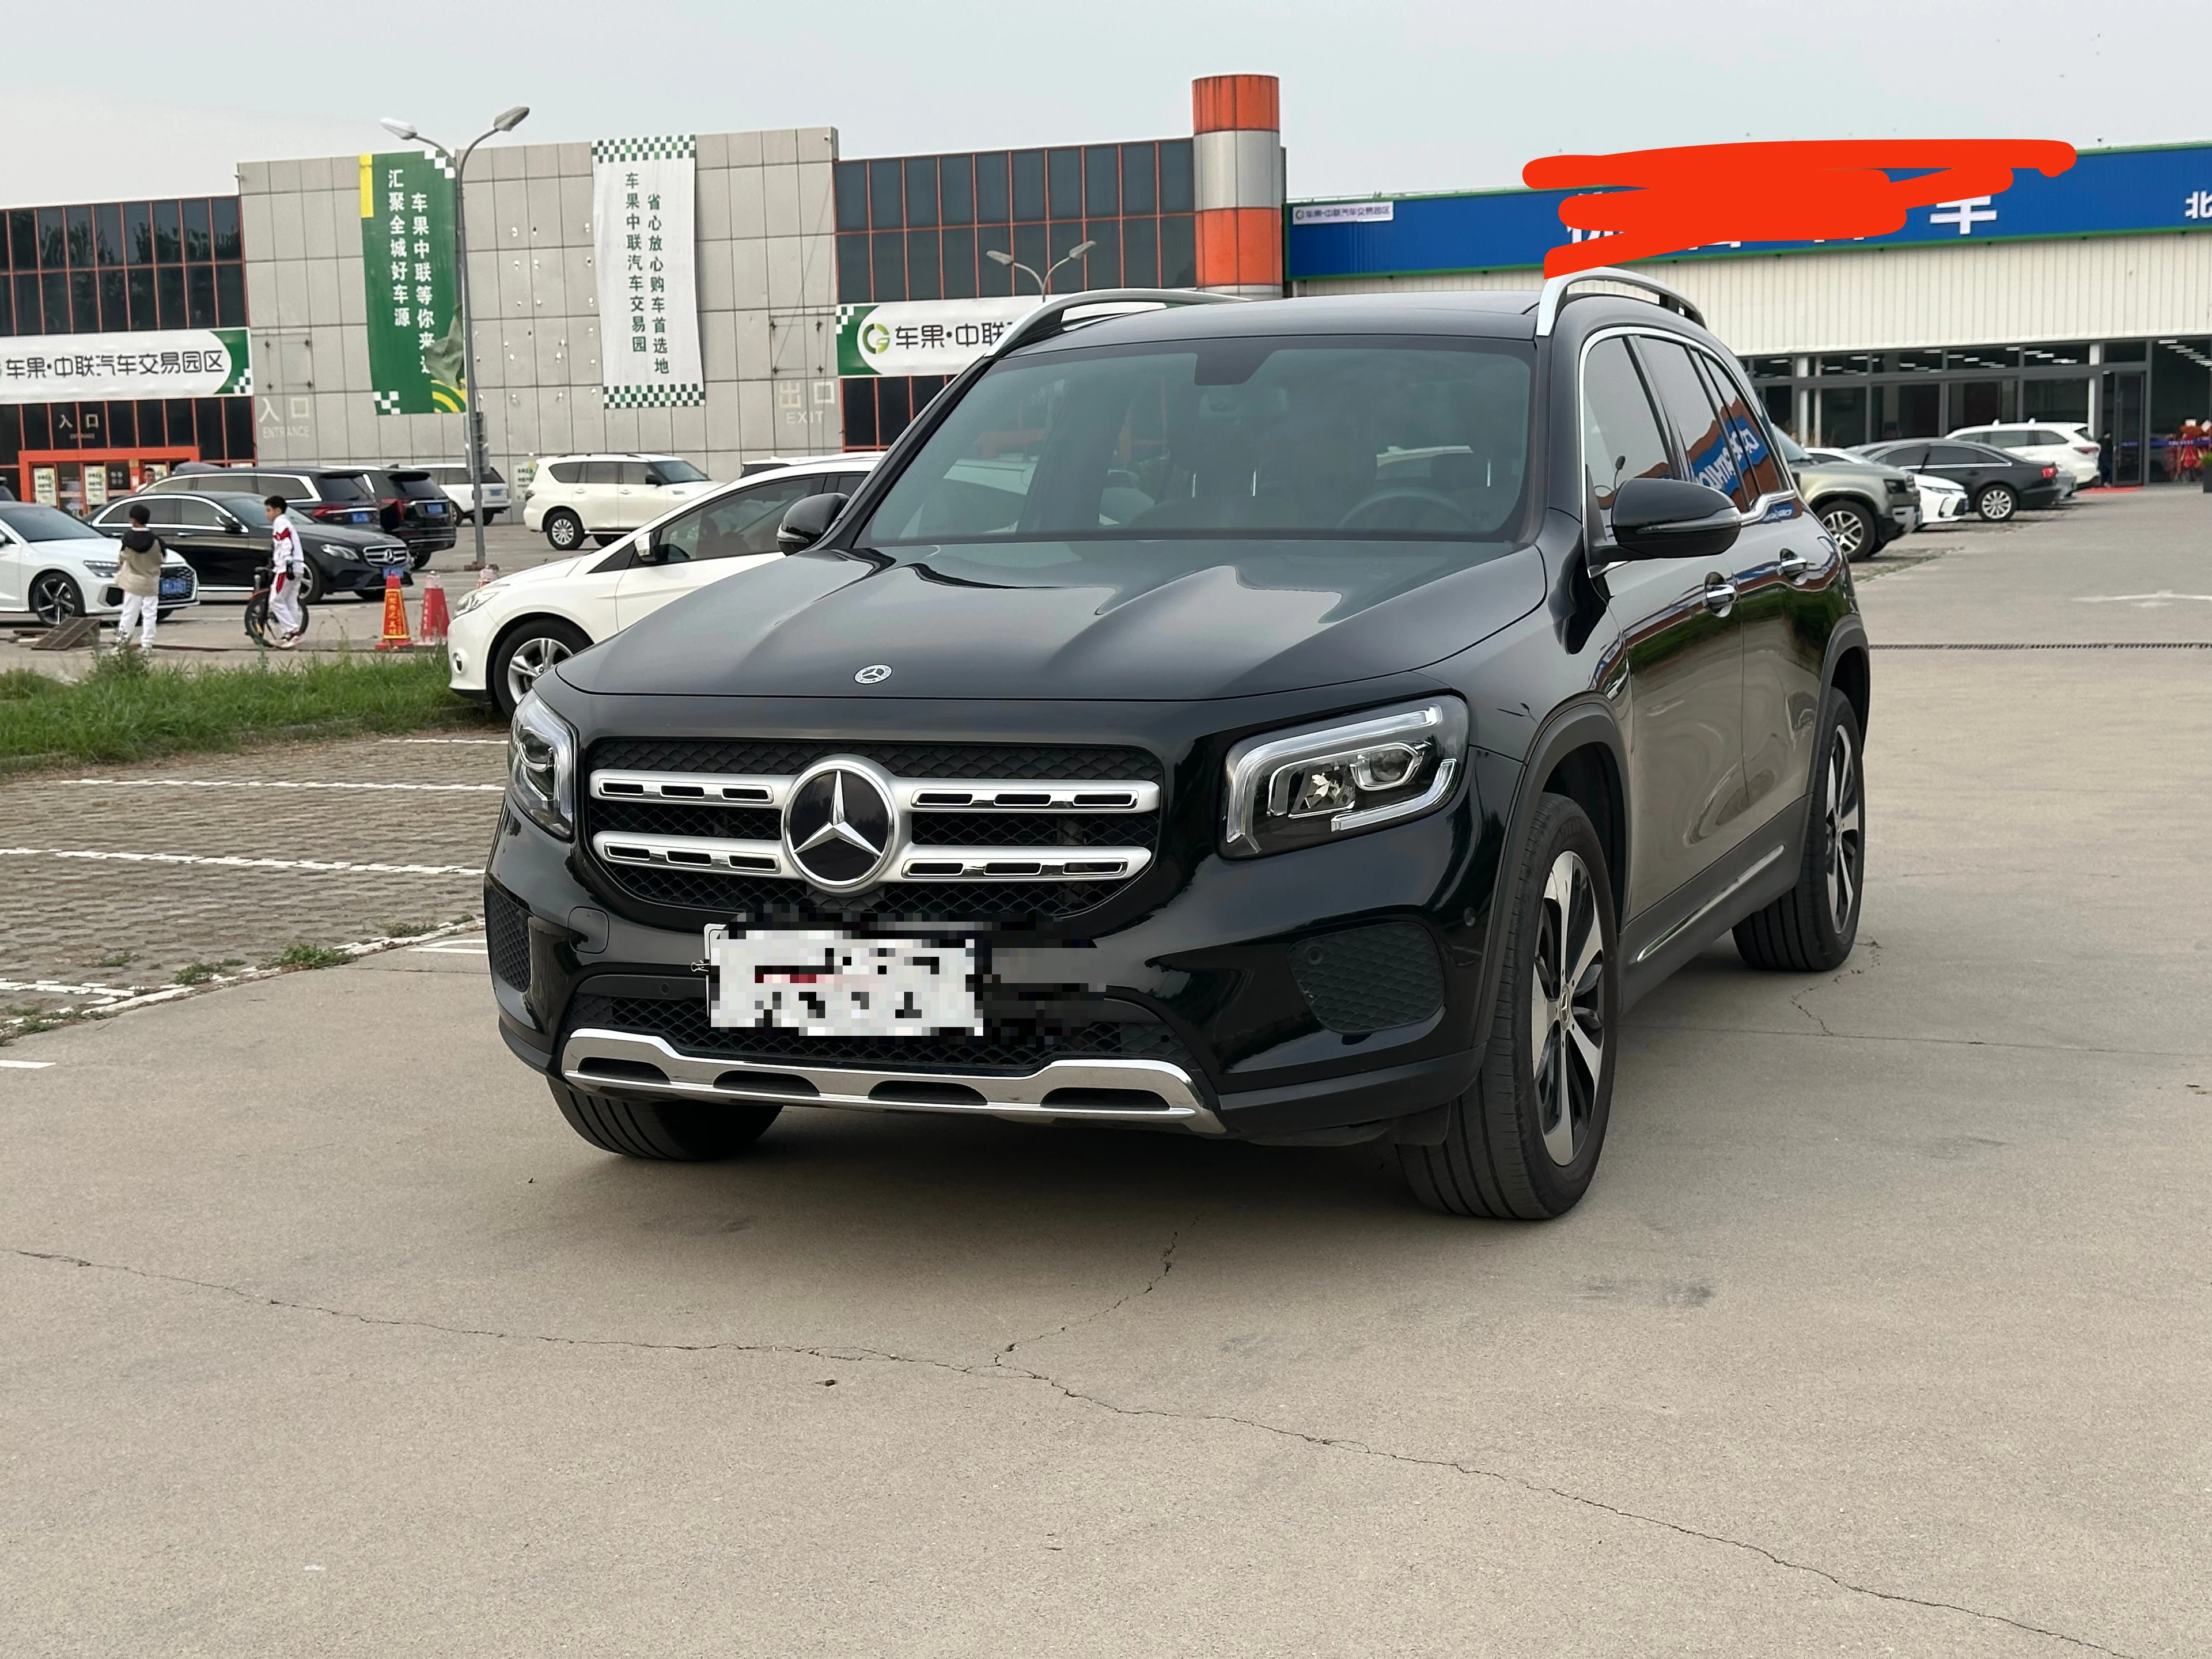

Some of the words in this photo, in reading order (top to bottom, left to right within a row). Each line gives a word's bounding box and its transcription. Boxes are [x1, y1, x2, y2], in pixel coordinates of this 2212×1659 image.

[388, 169, 410, 327] 汇聚全城好车源
[626, 172, 646, 352] 车果中联汽车交易园
[647, 193, 669, 374] 省心放心购车首选地
[895, 322, 1013, 349] 车果·中联
[6, 350, 225, 379] 车果·中联汽车交易园区
[779, 381, 835, 408] 出口
[59, 414, 99, 429] 入口
[259, 397, 309, 423] 入口
[786, 411, 824, 424] EXIT
